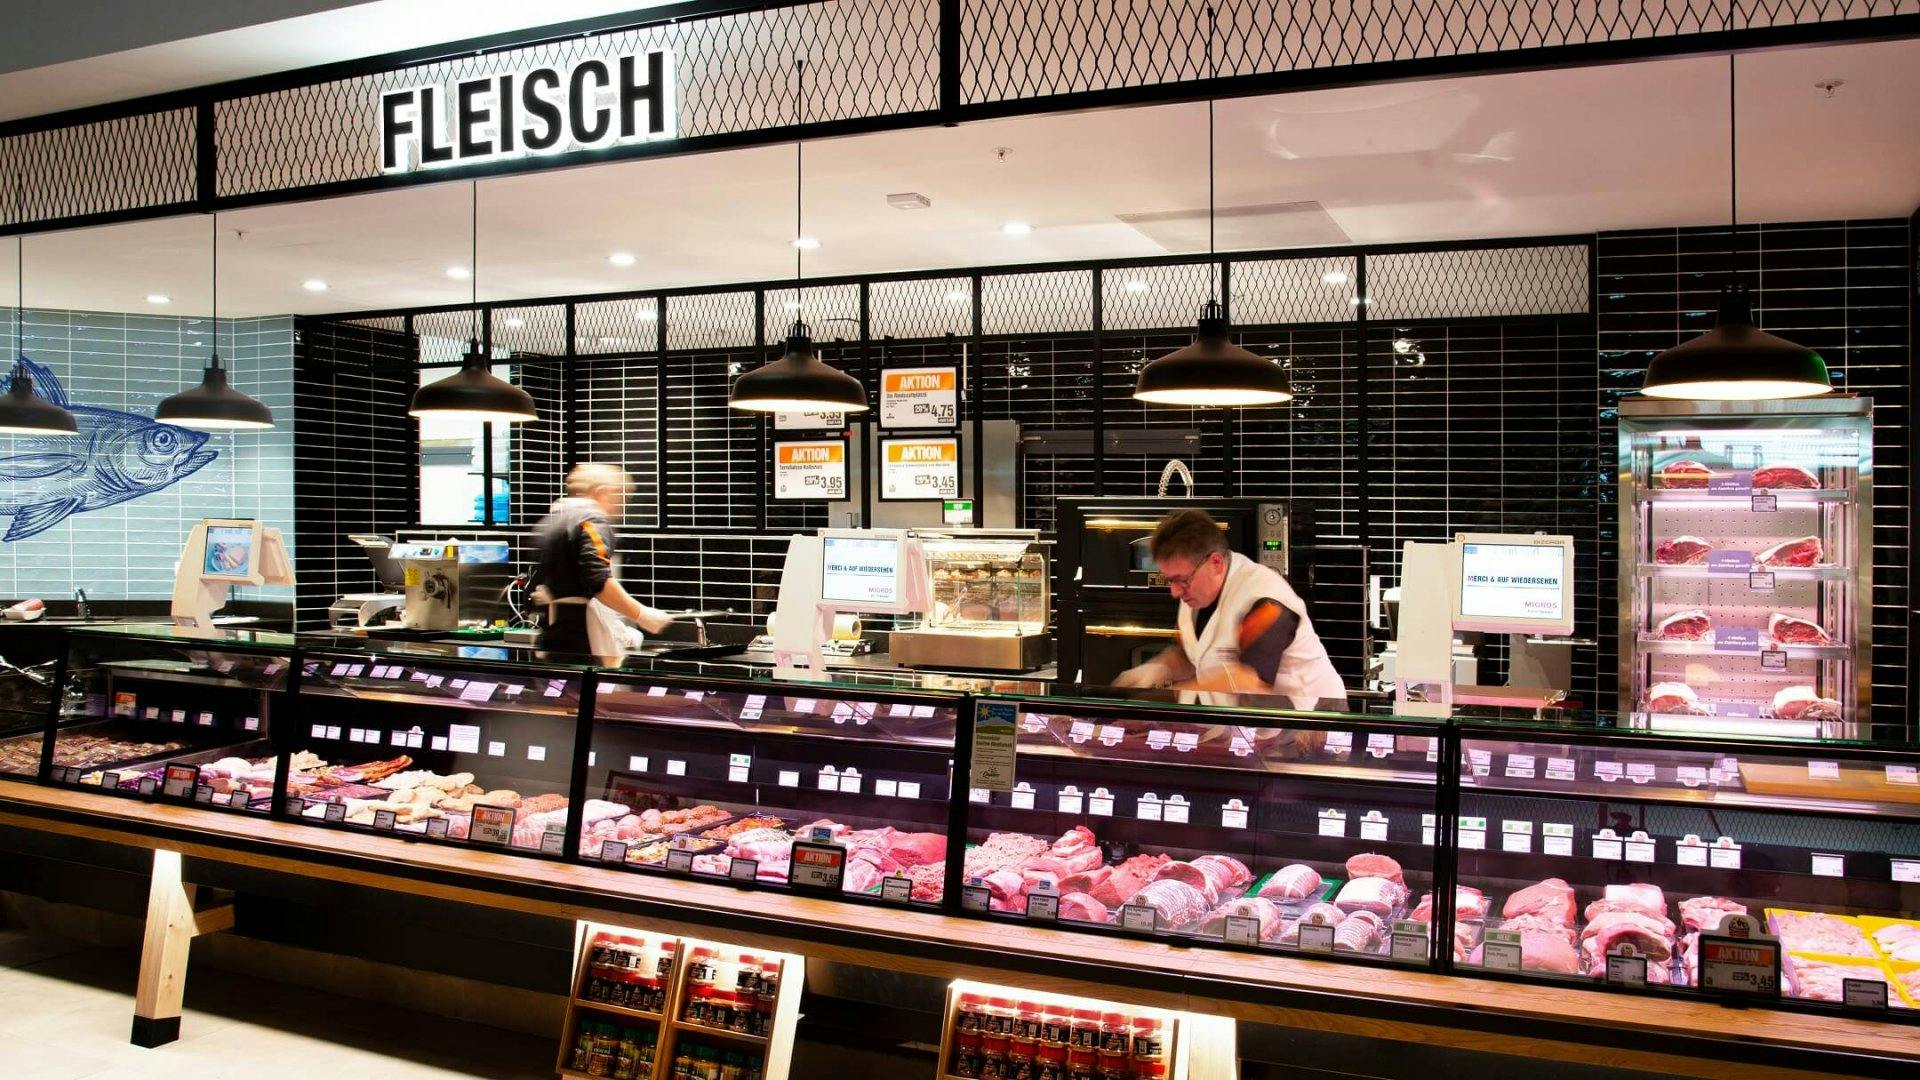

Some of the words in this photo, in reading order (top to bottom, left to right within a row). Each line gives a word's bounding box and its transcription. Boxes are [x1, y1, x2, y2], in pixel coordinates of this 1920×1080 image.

[383, 51, 664, 168] FLEISCH
[900, 375, 940, 389] AKTION
[931, 404, 954, 417] 4.75
[791, 447, 829, 461] AKTION
[901, 445, 941, 460] AKTION
[820, 476, 842, 489] 3.95
[932, 475, 955, 488] 3.45
[1467, 575, 1489, 583] MERCI
[1511, 576, 1558, 585] WIEDERSEHEN
[868, 586, 893, 594] MIGROS
[1524, 601, 1558, 609] MIGROS
[804, 852, 832, 864] AKTION
[1718, 946, 1759, 962] AKTION
